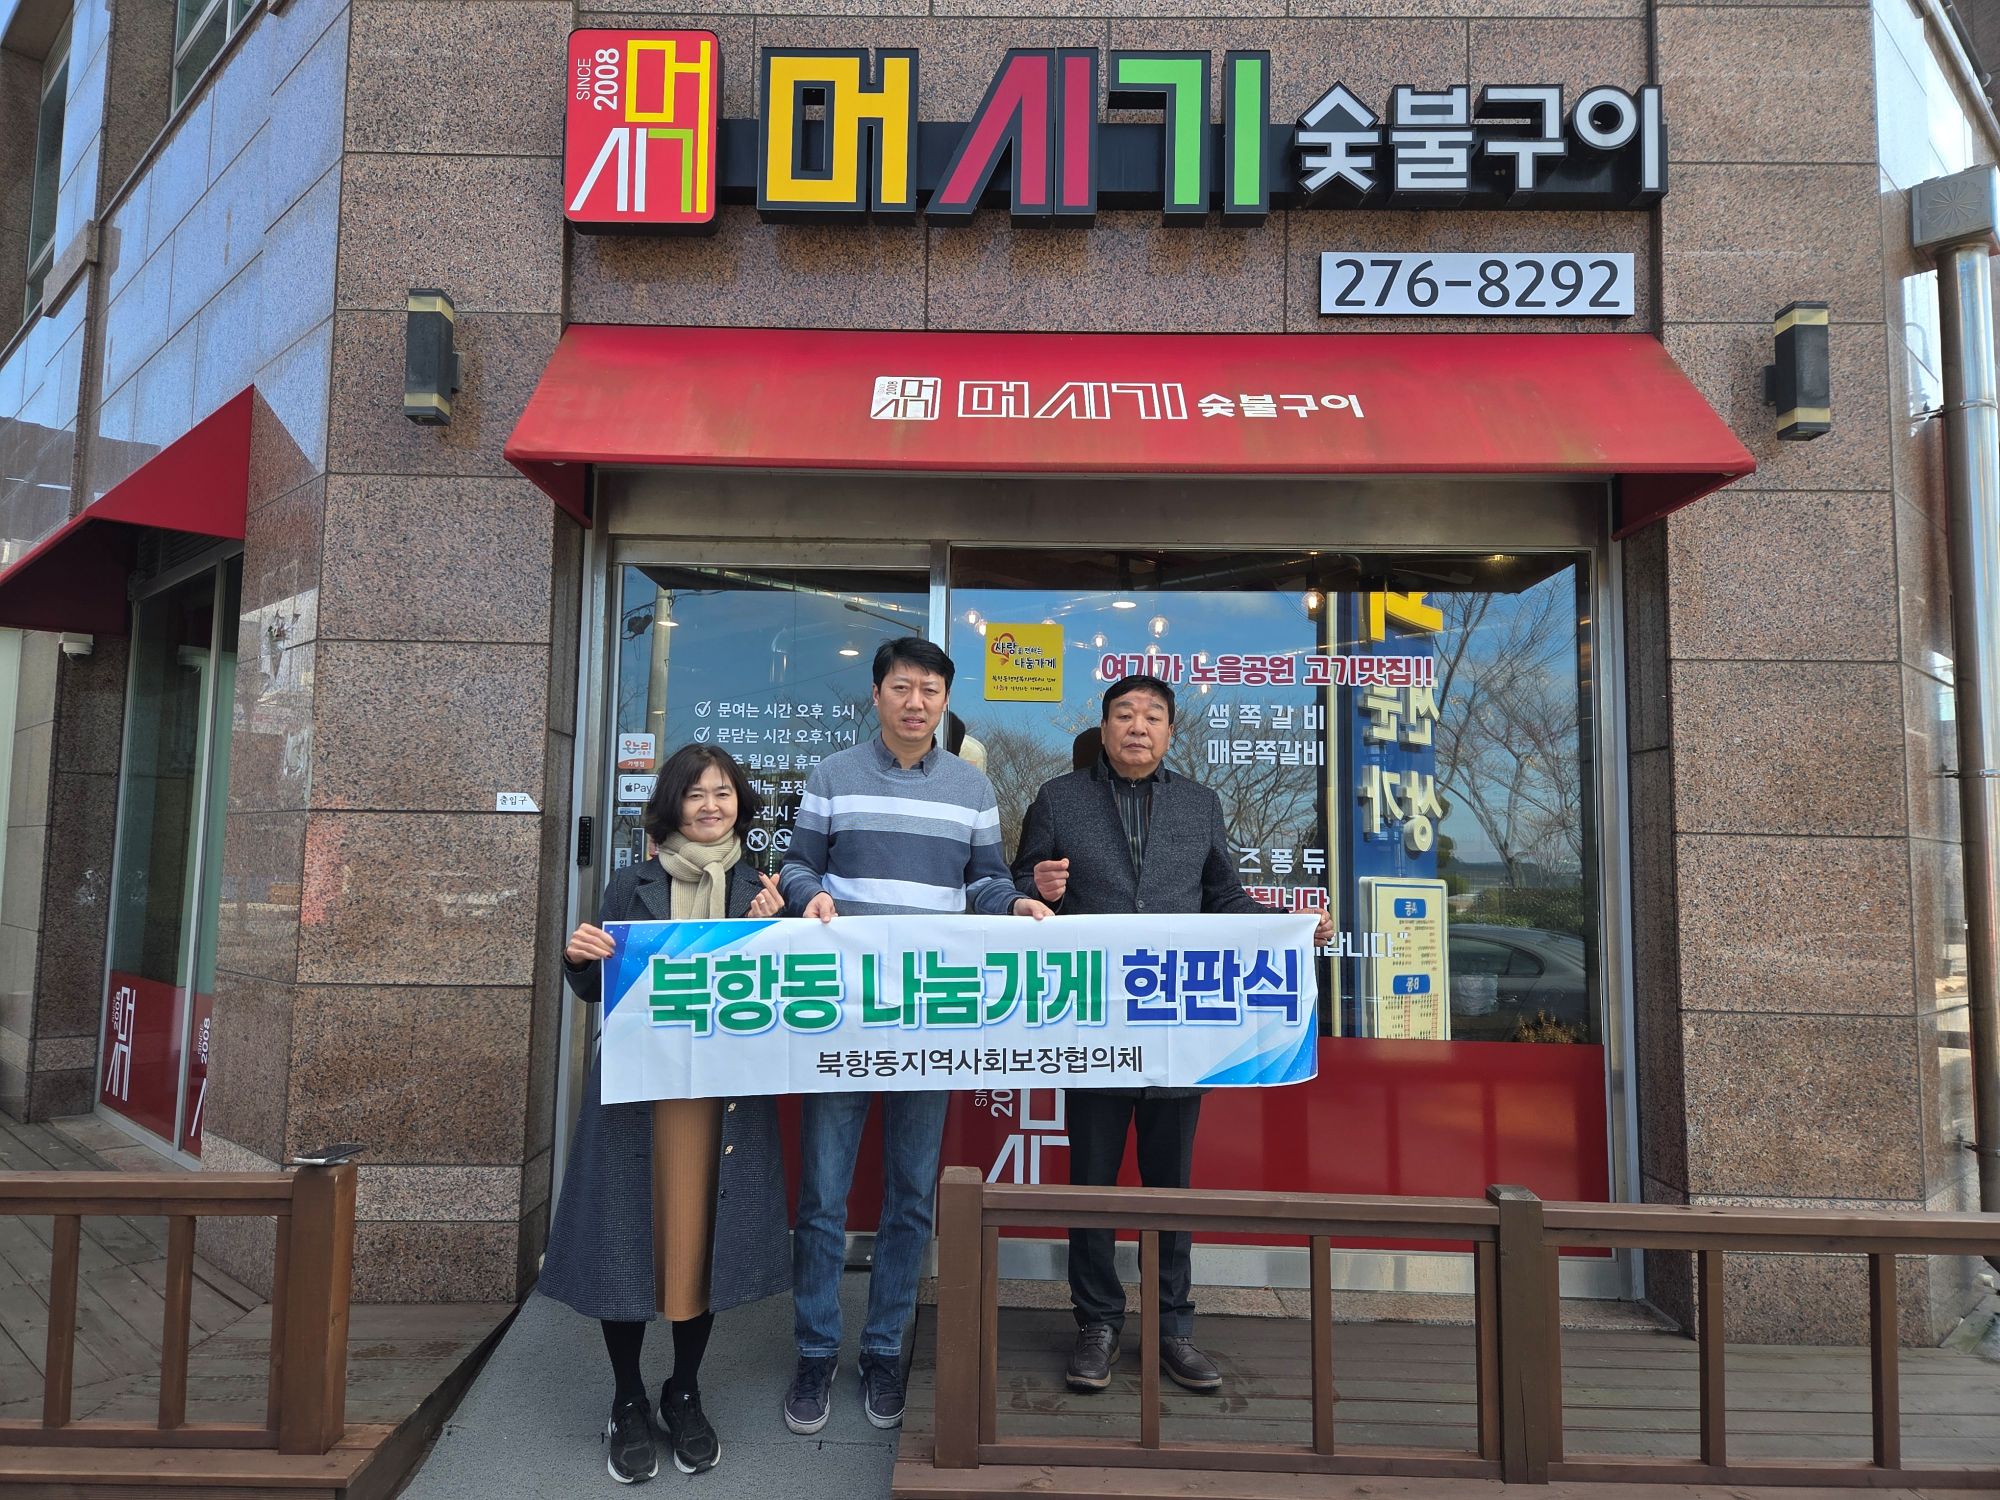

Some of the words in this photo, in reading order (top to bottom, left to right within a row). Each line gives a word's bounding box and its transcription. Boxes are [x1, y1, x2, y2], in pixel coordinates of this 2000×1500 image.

[576, 57, 591, 101] SINCE
[594, 47, 620, 111] 2008
[758, 48, 1270, 214] 머시기
[1297, 81, 1661, 193] 숯불구이
[1334, 259, 1620, 308] 276-8292
[957, 381, 1189, 420] 머시기
[1197, 393, 1365, 418] 숯불구이
[1015, 656, 1057, 670] 나눔가게
[1100, 653, 1184, 685] 여기가
[1190, 654, 1295, 686] 노을공원
[1302, 655, 1435, 688] 고기맛집!!
[717, 703, 760, 718] 문여는
[764, 703, 792, 718] 시간
[796, 704, 824, 719] 오후
[832, 704, 855, 720] 5시
[716, 728, 760, 743] 문닫는
[763, 729, 791, 743] 시간
[749, 754, 790, 770] 월요일
[794, 754, 821, 769] 휴무
[1207, 740, 1325, 766] 매운쪽갈비
[500, 795, 527, 805] 출입구
[633, 783, 653, 795] Pay
[648, 953, 844, 1034] 북항동
[861, 950, 1103, 1027] 나눔가게
[1122, 948, 1300, 1023] 현판식
[200, 1017, 211, 1065] 2008
[816, 1046, 1143, 1077] 북항동지역사회보장협의체
